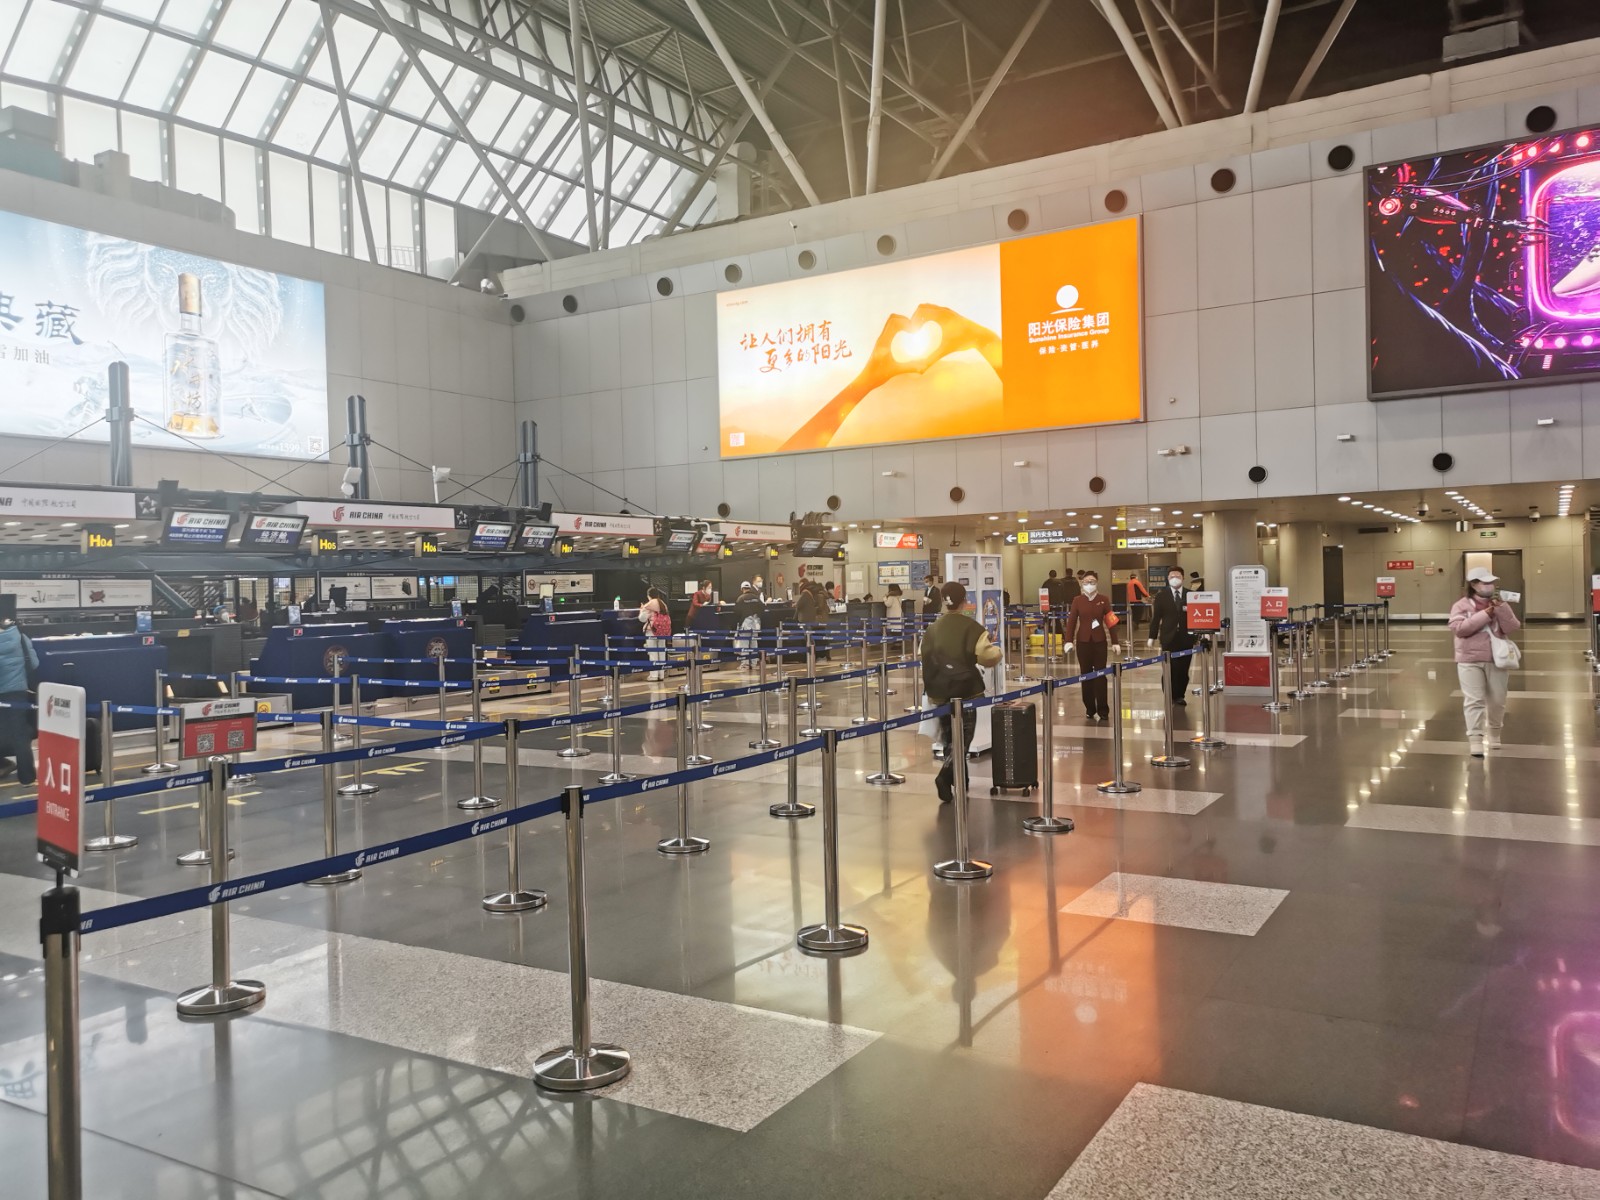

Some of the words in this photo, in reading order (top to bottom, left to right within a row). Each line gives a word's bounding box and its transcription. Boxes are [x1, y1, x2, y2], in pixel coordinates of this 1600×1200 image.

[1028, 312, 1110, 337] 阳光保险集团
[740, 320, 832, 351] 让人们拥有
[1028, 335, 1057, 344] Sunshine
[1058, 330, 1088, 340] Insurance
[760, 340, 852, 373] 更多的阳光
[89, 534, 113, 547] H04
[261, 531, 288, 539] 经济舱
[320, 539, 337, 550] H05
[423, 541, 437, 552] H06
[1193, 608, 1214, 617] 入口
[44, 757, 71, 795] 入口
[186, 776, 204, 784] CHINA
[46, 801, 70, 821] ENTRANCE
[480, 823, 490, 831] AIR
[490, 817, 508, 829] CHINA
[365, 854, 377, 863] AIR
[378, 847, 400, 859] CHINA
[222, 887, 237, 898] AIR
[238, 880, 265, 894] CHINA
